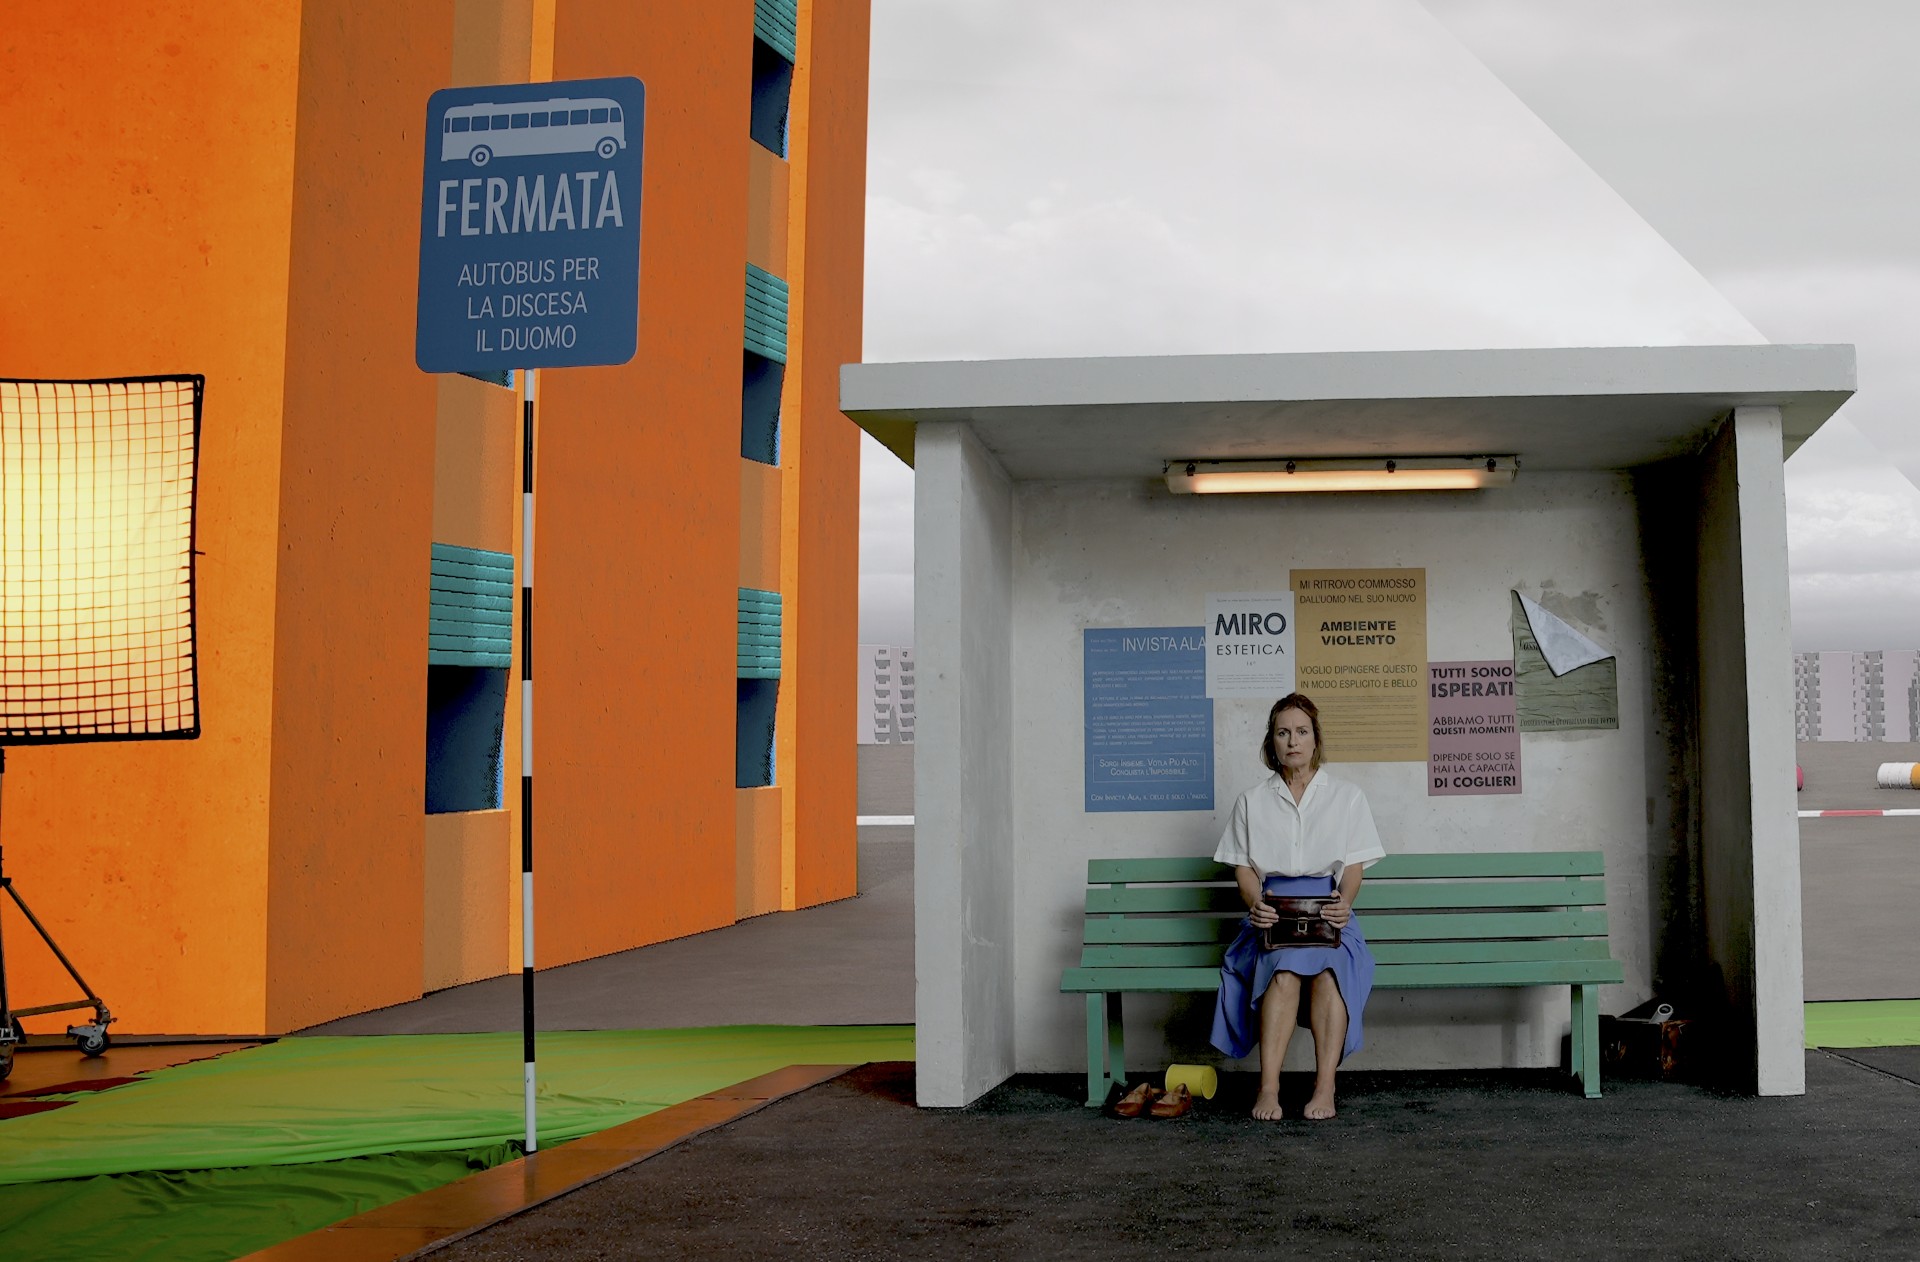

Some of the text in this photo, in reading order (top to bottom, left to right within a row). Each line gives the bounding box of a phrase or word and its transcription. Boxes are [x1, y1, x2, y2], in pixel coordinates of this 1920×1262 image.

[437, 170, 624, 237] FERMATA
[458, 257, 599, 286] AUTOBUS PER
[467, 291, 588, 319] LA DISCESA
[476, 325, 577, 352] IL DUOMO
[1300, 578, 1416, 589] MI RITROVO COMMOSSO
[1300, 593, 1416, 603] DALL'UOMO NEL SUO NUOVO
[1215, 612, 1287, 635] MIRO
[1320, 620, 1396, 631] AMBIENTE
[1122, 637, 1178, 652] INVISTA
[1321, 635, 1396, 645] VIOLENTO
[1216, 644, 1285, 655] ESTETICA
[1300, 664, 1418, 675] VOGLIO DIPINGERE QUESTO
[1431, 666, 1513, 678] TUTTI SONO
[1300, 679, 1418, 689] IN MODO ESPLICITO E BELLO
[1431, 681, 1514, 698] ISPERATI
[1433, 715, 1484, 725] ABBIAMO
[1488, 715, 1515, 724] TUTTI
[1433, 726, 1515, 735] QUESTI MOMENTI
[1433, 752, 1515, 761] DIPENDE SOLO SE
[1433, 761, 1515, 773] HAI LA CAPACITÀ
[1434, 776, 1516, 788] DI COGLIERI
